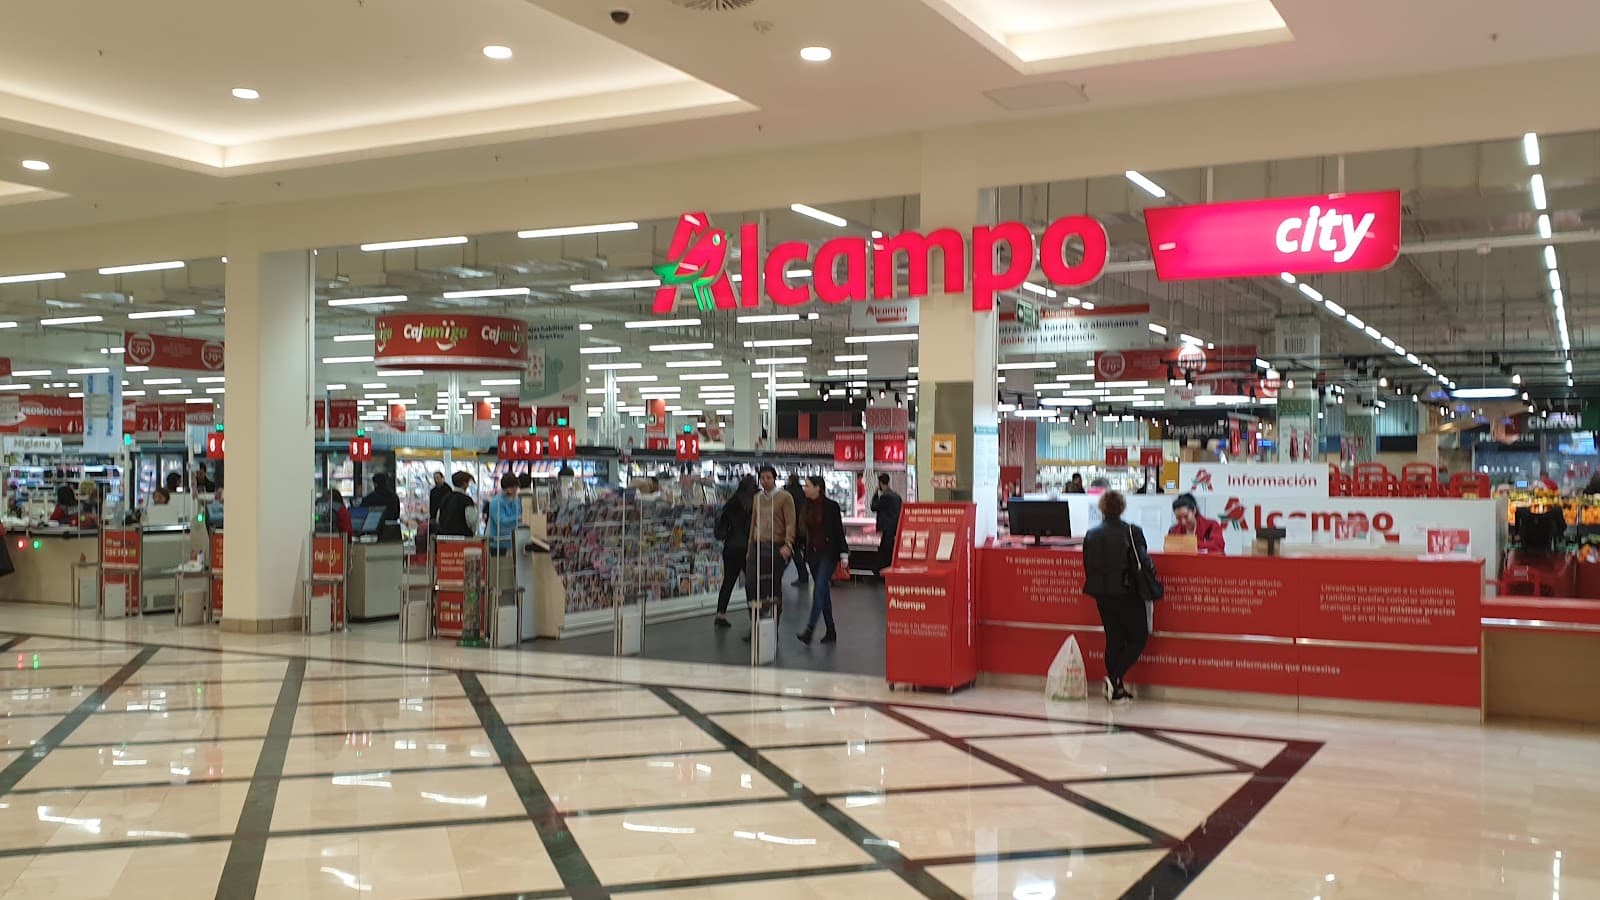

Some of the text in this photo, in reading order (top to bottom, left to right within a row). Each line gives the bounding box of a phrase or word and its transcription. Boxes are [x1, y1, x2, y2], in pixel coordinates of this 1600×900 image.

[1276, 206, 1375, 262] city
[653, 212, 1108, 313] Alcampo
[1091, 319, 1138, 330] abonamos
[1001, 336, 1024, 345] doble
[1027, 335, 1037, 344] de
[1040, 334, 1048, 343] la
[14, 439, 60, 450] Higiene y
[553, 434, 559, 450] 1
[567, 434, 573, 450] 1
[680, 439, 686, 454] 2
[691, 439, 697, 454] 2
[1227, 473, 1317, 488] Información
[1218, 496, 1395, 534] Alcmpo
[888, 585, 946, 597] sugerencias
[889, 598, 926, 612] Alcampo
[1088, 651, 1104, 659] Esta
[1138, 653, 1177, 664] isposición
